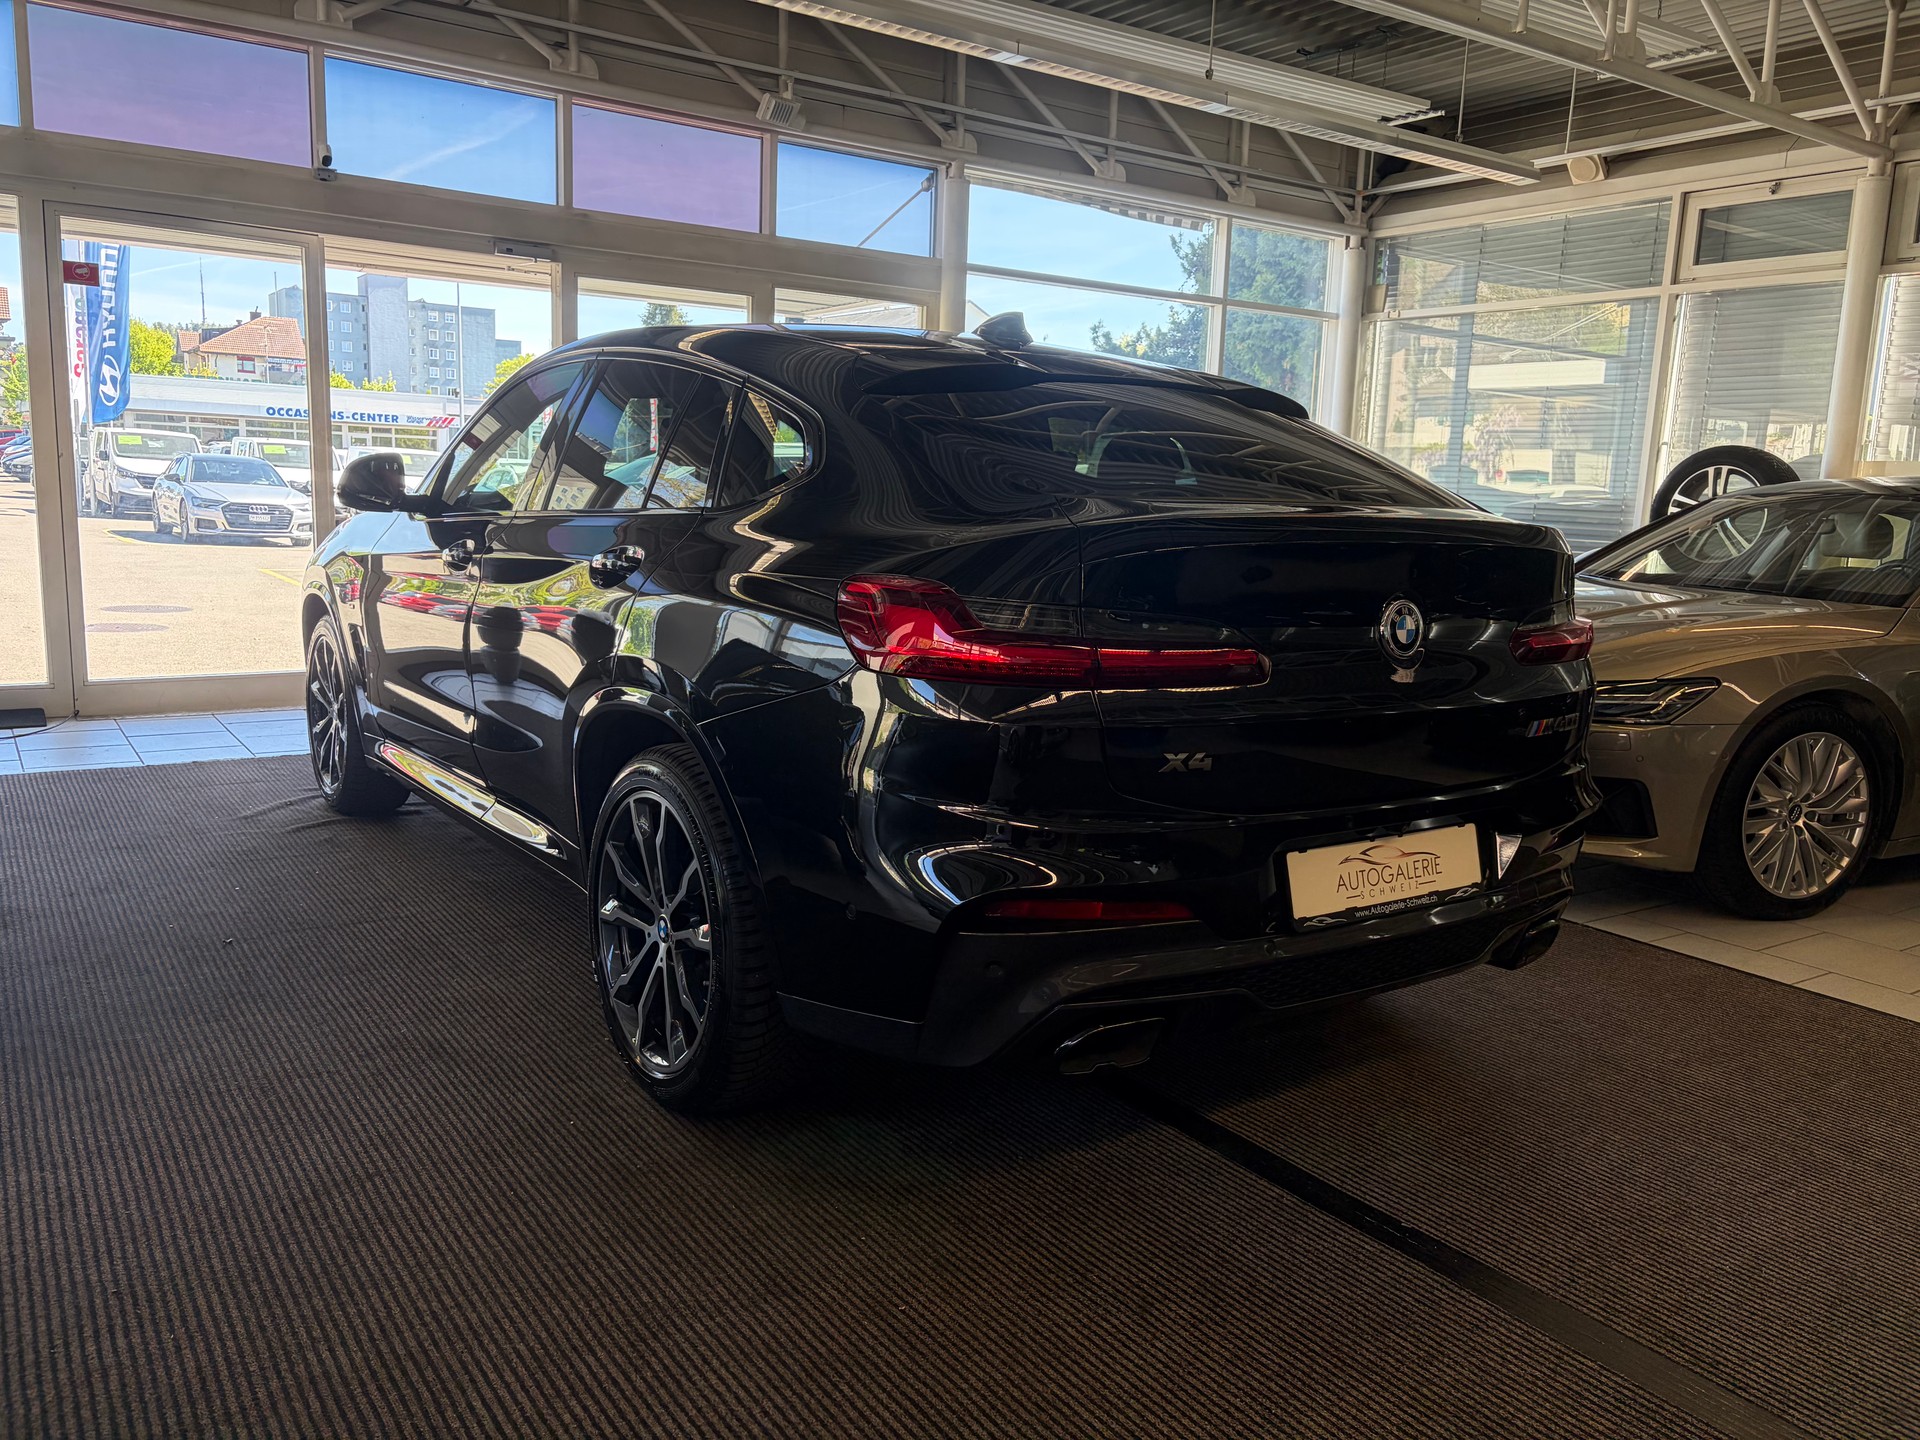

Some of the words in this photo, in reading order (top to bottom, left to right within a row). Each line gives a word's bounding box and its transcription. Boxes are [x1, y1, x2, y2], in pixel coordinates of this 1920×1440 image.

[266, 406, 399, 423] OCCASNS-CENTER
[1158, 752, 1212, 773] X4
[1336, 856, 1443, 893] AUTOGALERIE
[1360, 880, 1420, 900] SCHWEIZ
[1354, 894, 1438, 918] www.Autogalerie-Schweiz.ch
